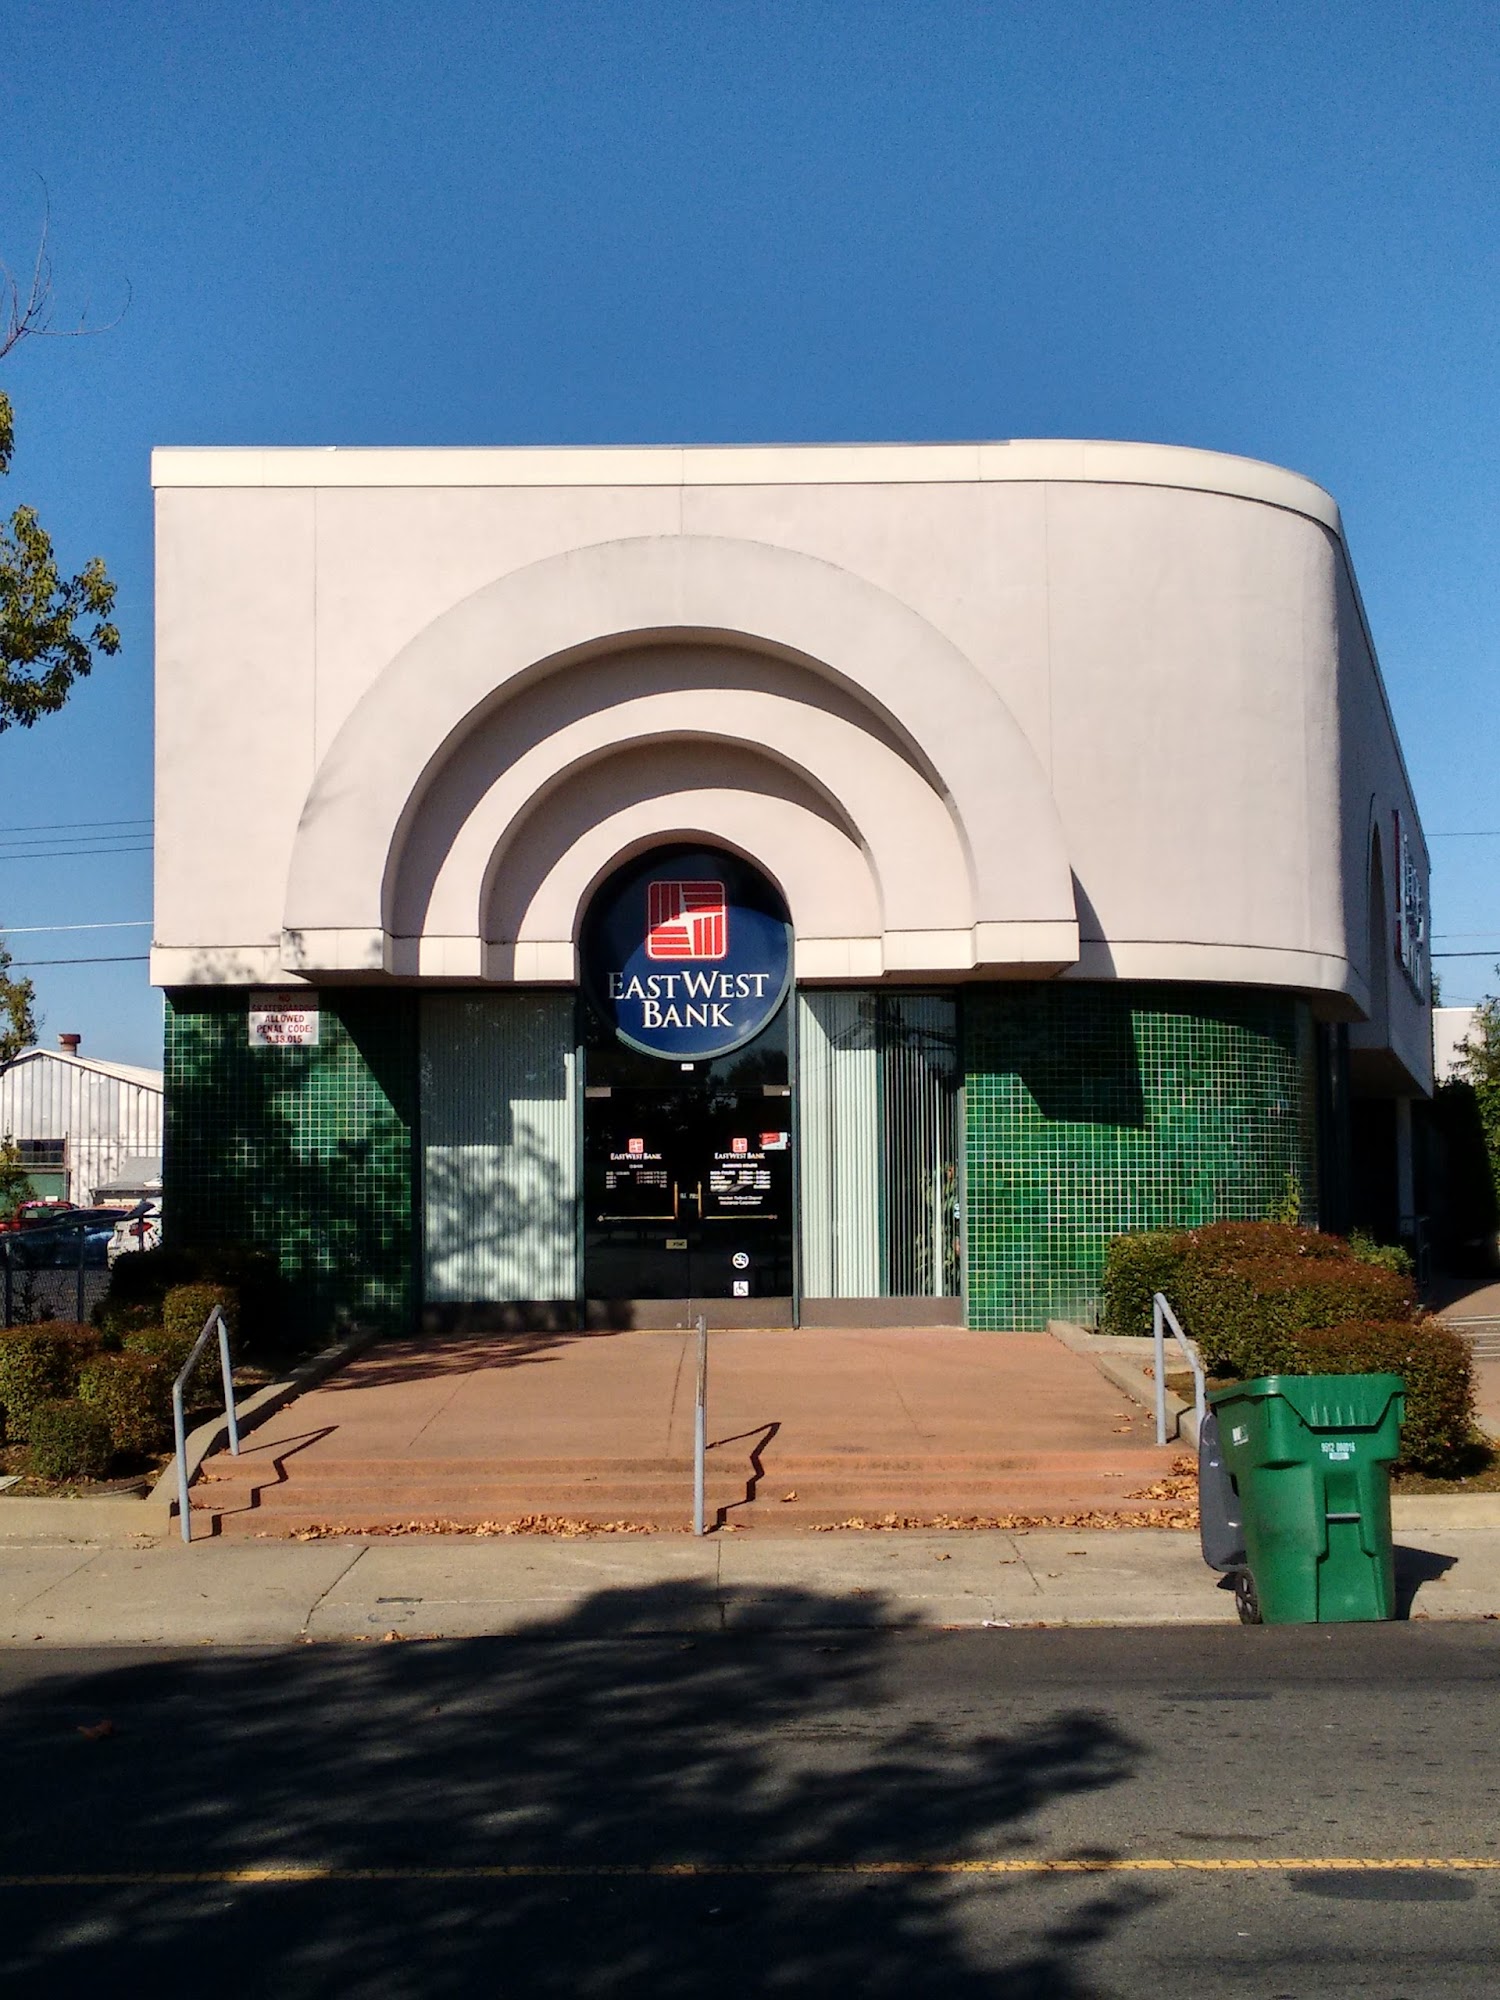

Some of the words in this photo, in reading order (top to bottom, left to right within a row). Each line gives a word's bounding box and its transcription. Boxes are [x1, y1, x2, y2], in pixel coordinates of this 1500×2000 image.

[265, 1014, 305, 1023] ALLOWED
[642, 1000, 734, 1029] BANK
[256, 1025, 283, 1033] PENAL
[288, 1024, 313, 1033] CODE:
